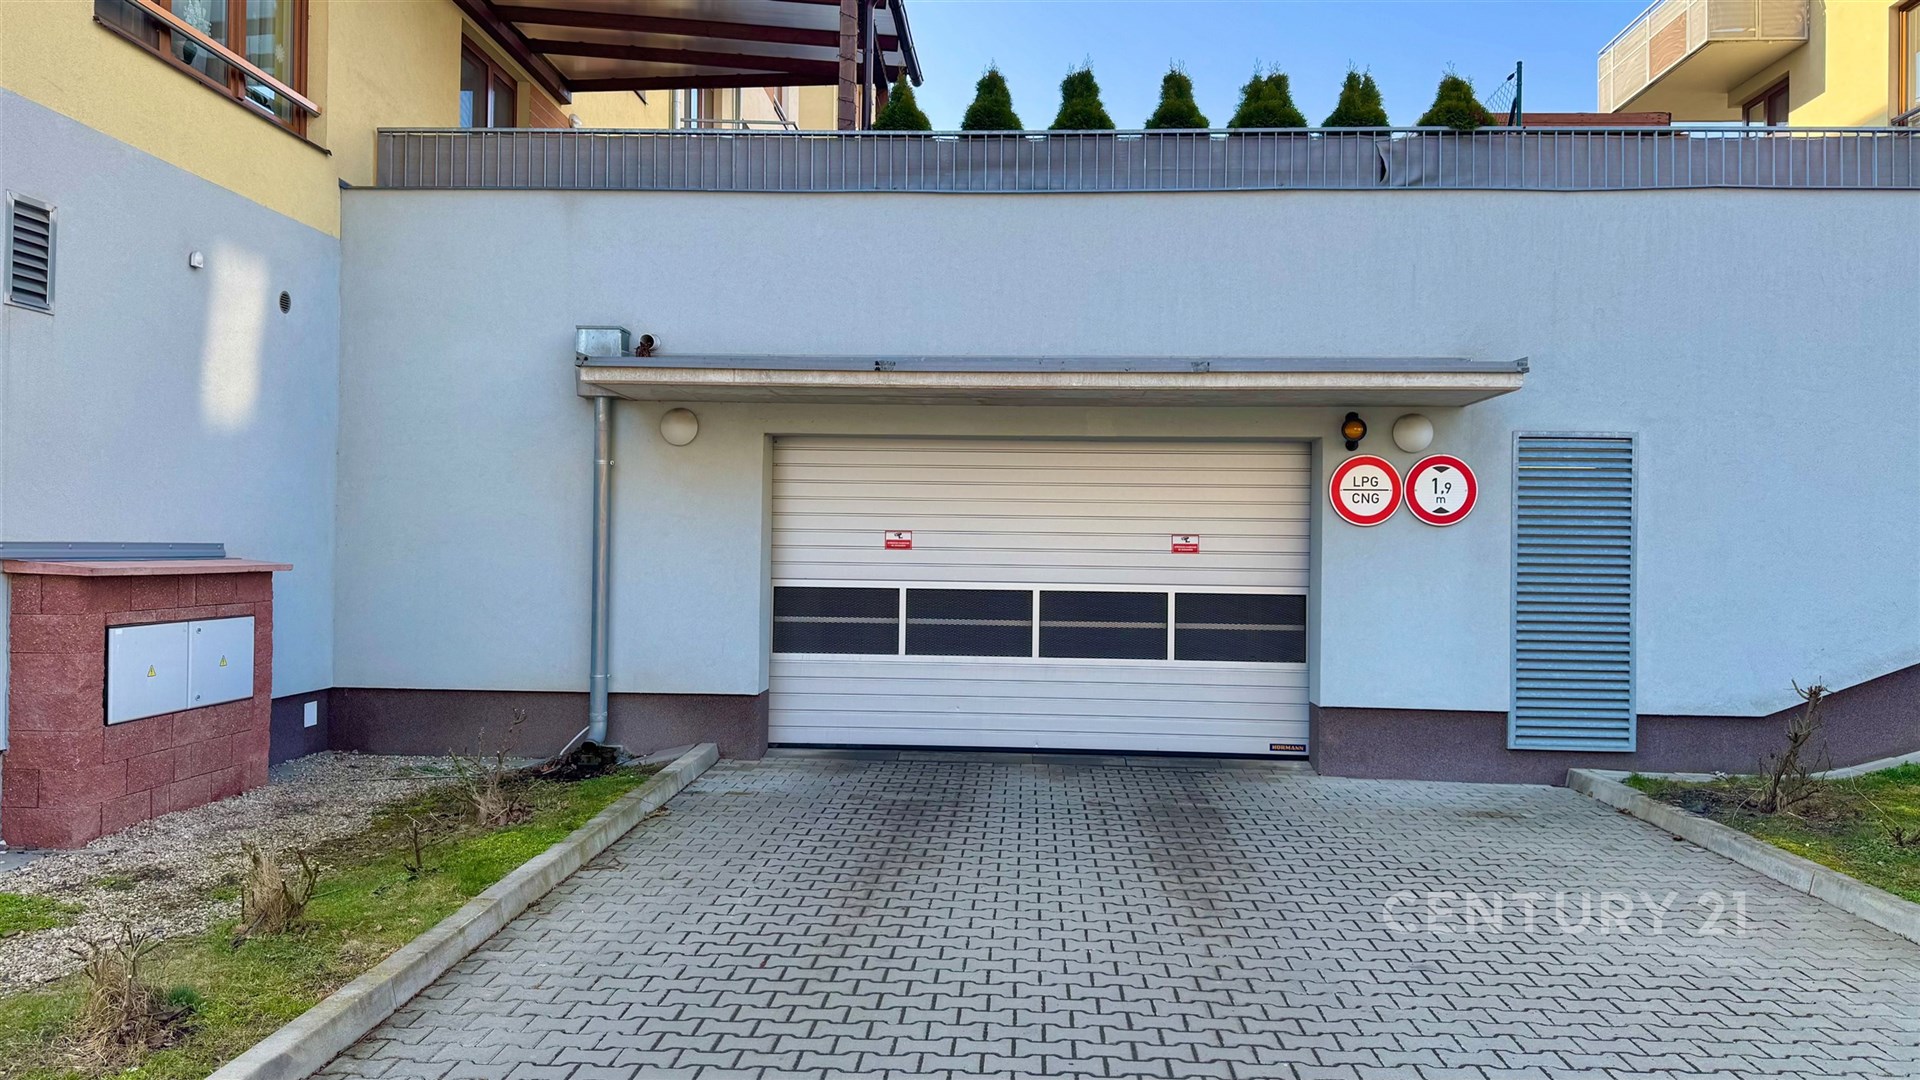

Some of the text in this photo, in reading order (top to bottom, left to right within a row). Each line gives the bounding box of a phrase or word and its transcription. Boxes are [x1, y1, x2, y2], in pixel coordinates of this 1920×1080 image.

[1353, 476, 1379, 488] LPG
[1431, 477, 1452, 495] 1,9
[1352, 492, 1380, 504] CNG
[1435, 496, 1446, 504] m
